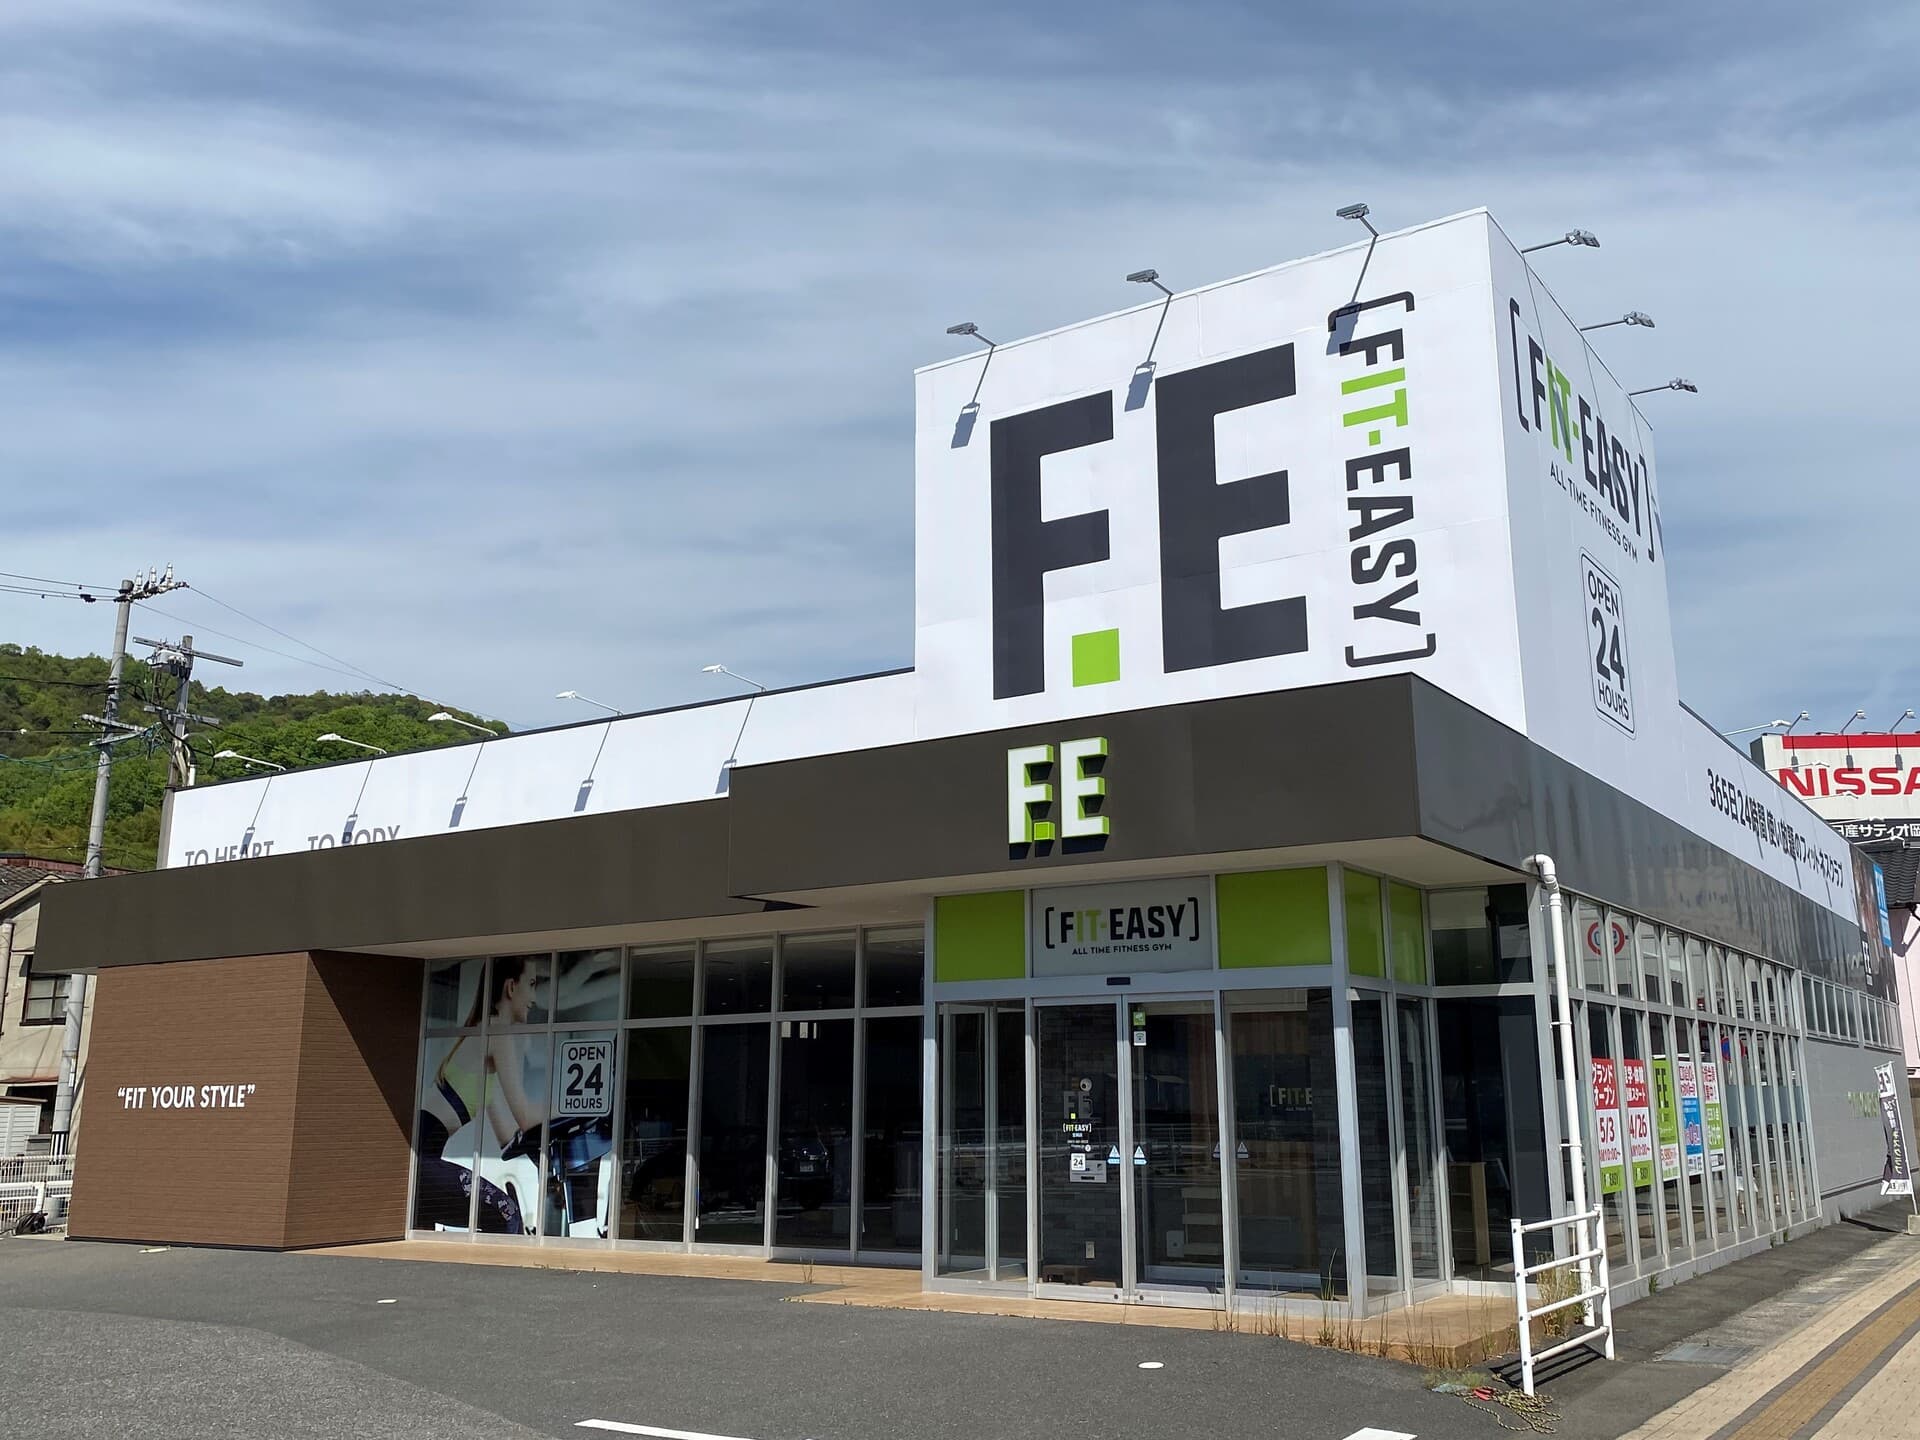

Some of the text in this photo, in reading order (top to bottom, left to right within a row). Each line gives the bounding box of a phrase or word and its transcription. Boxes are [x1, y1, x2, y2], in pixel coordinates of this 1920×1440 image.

[1550, 460, 1638, 563] ALL TIME FITNESS GYM
[1587, 570, 1620, 619] OPEN
[1591, 607, 1625, 692] 24
[1597, 679, 1630, 720] HOURS
[307, 834, 335, 851] TO
[184, 849, 209, 867] TO
[1071, 943, 1172, 955] ALL TIME FITNESS GYM
[567, 1046, 605, 1060] OPEN
[566, 1062, 603, 1096] 24
[151, 1086, 195, 1109] YOUR
[565, 1097, 602, 1109] HOURS
[1599, 1116, 1615, 1144] 5/3
[1629, 1115, 1647, 1139] 4/26
[1073, 1157, 1084, 1167] 24
